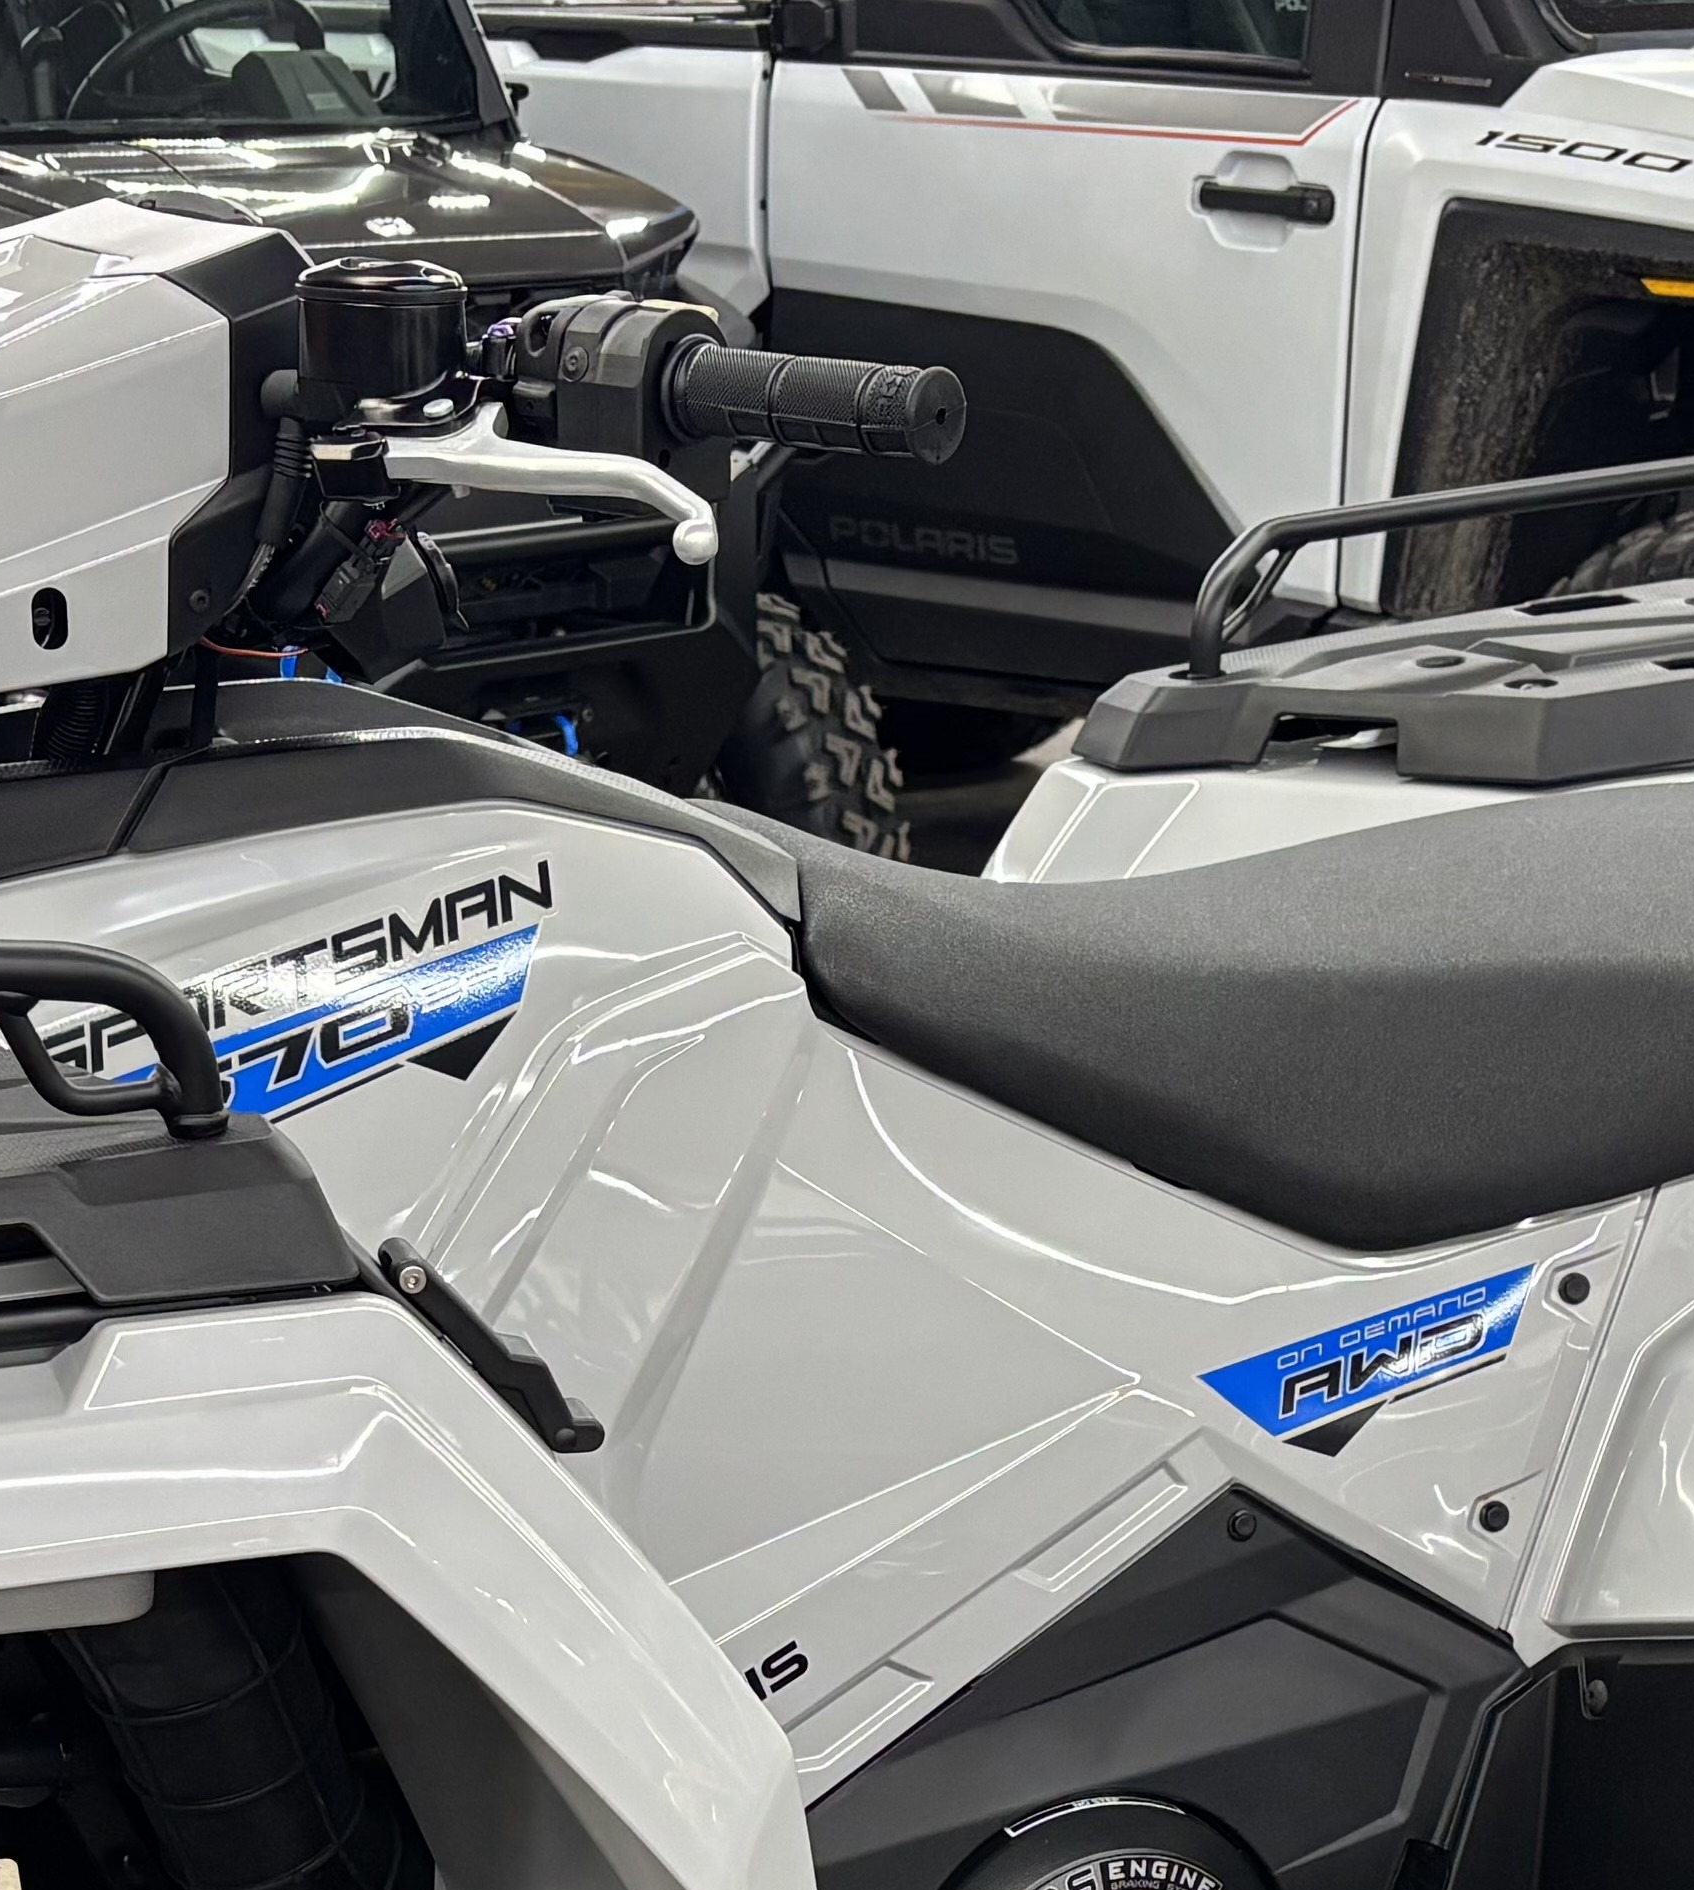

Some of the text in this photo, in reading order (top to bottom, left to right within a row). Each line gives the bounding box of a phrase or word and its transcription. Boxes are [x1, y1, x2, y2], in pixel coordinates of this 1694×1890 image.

[1476, 131, 1694, 173] 1500
[829, 515, 1020, 566] POLARIS
[43, 860, 554, 1074] SPRTSMAN
[1277, 1286, 1486, 1370] ON DEMAND
[1279, 1313, 1488, 1420] AWD
[1110, 1878, 1160, 1890] BRAKING
